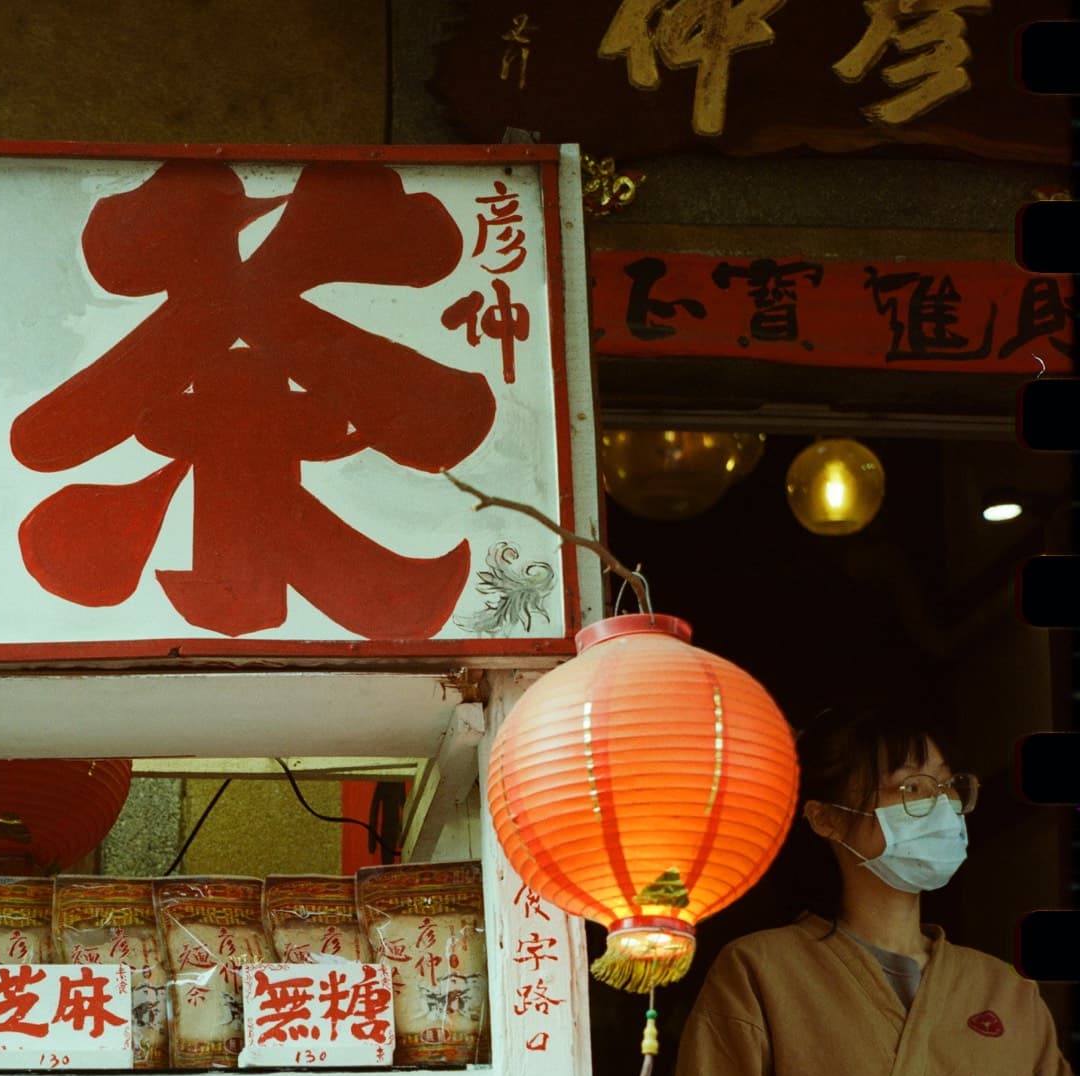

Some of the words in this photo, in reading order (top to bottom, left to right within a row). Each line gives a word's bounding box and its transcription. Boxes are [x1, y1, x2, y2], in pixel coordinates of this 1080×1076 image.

[442, 181, 531, 384] 彥仲
[254, 964, 391, 1044] 無糖
[39, 1054, 70, 1067] 130
[295, 1050, 326, 1063] 130
